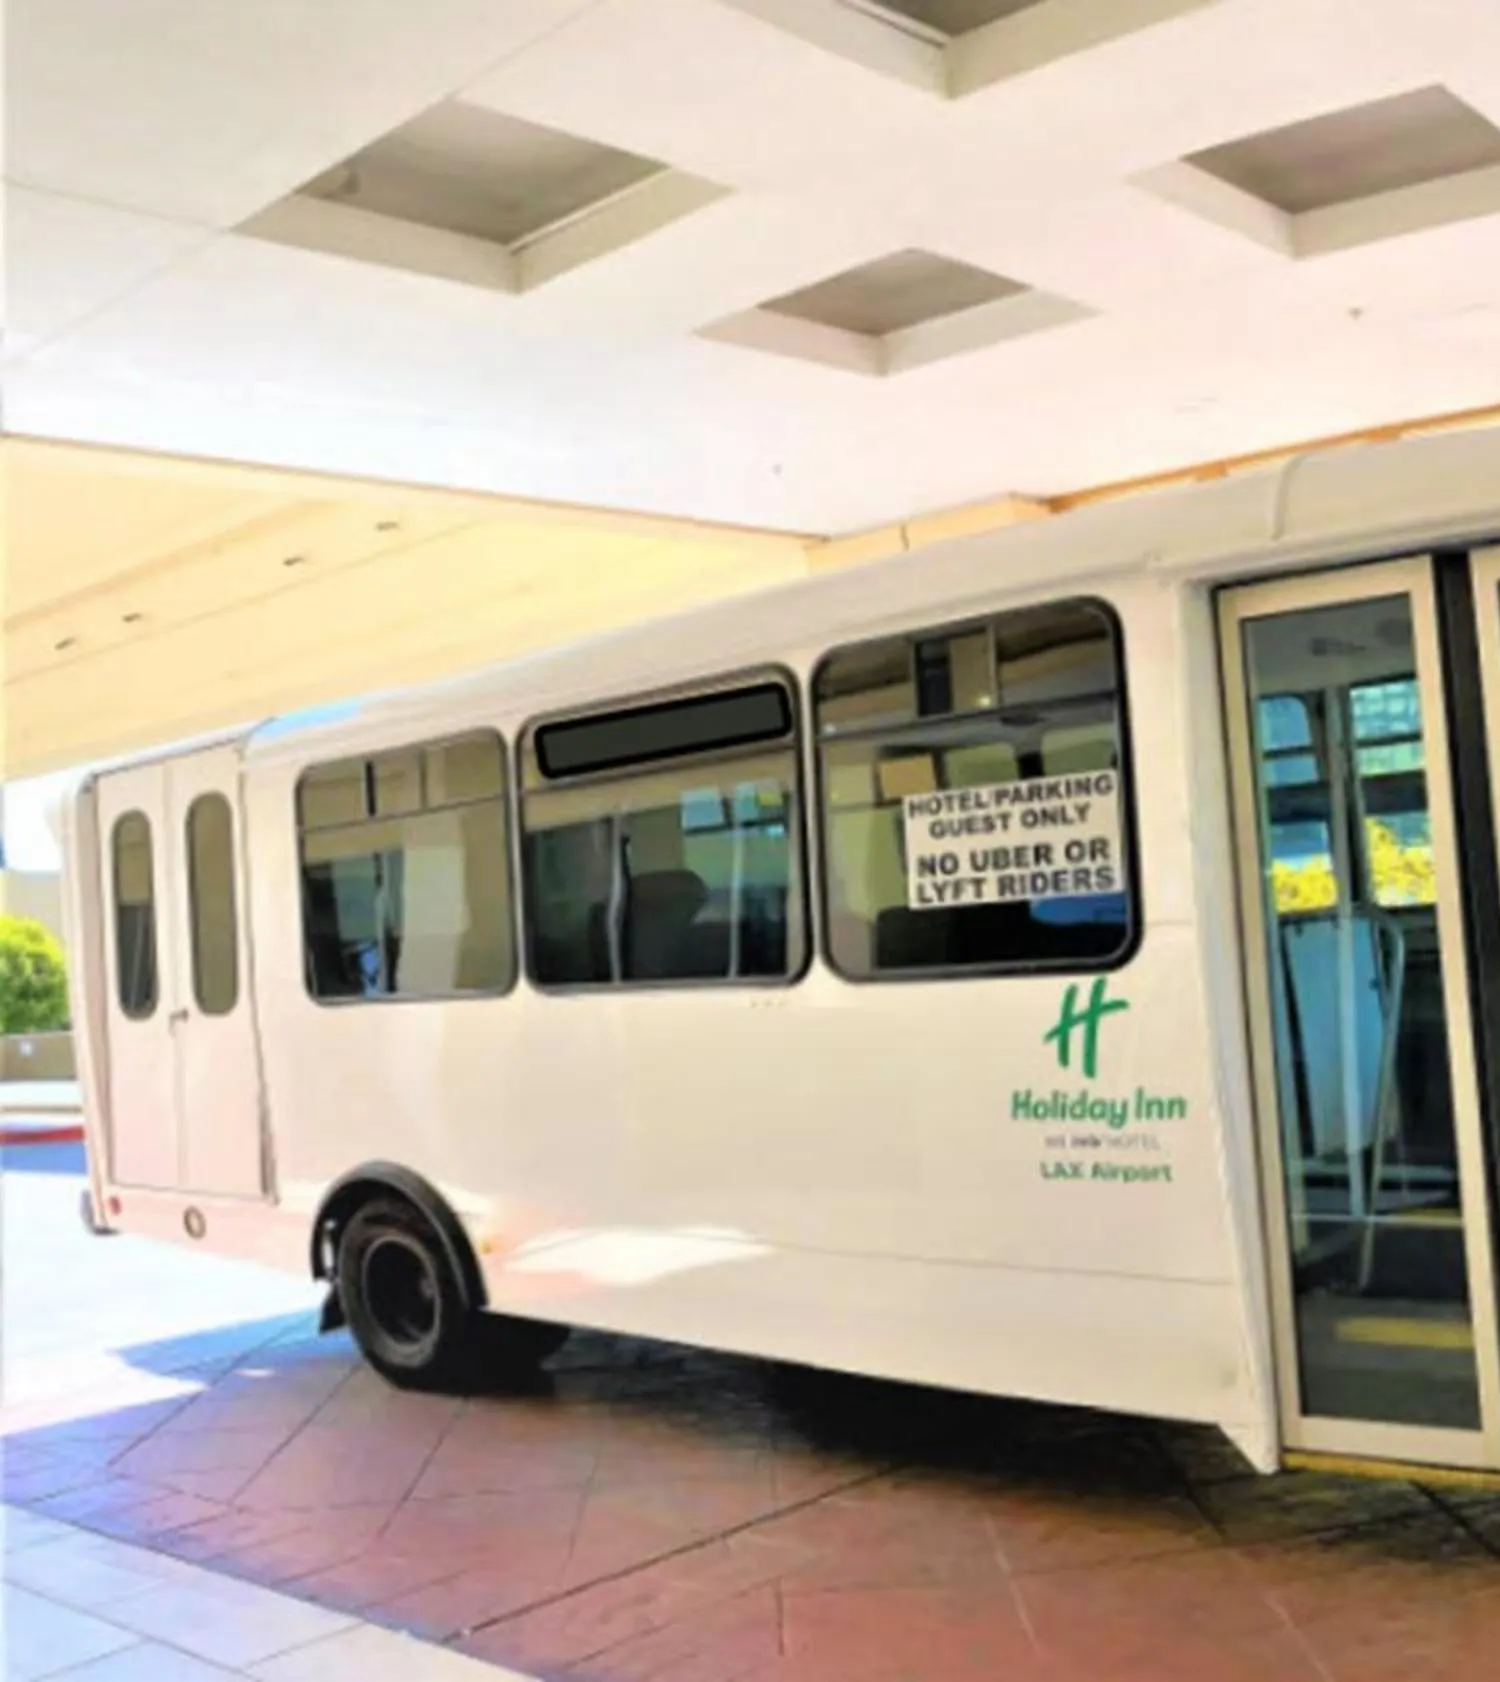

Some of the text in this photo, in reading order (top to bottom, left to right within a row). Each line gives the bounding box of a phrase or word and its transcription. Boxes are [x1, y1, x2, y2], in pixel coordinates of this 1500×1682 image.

[928, 803, 1090, 839] GUEST ONLY
[916, 838, 1109, 877] NO UBER OR
[916, 866, 1114, 904] LYFT RIDERS
[1010, 1086, 1187, 1129] Holiday Inn
[1039, 1161, 1173, 1183] LAX Airport
